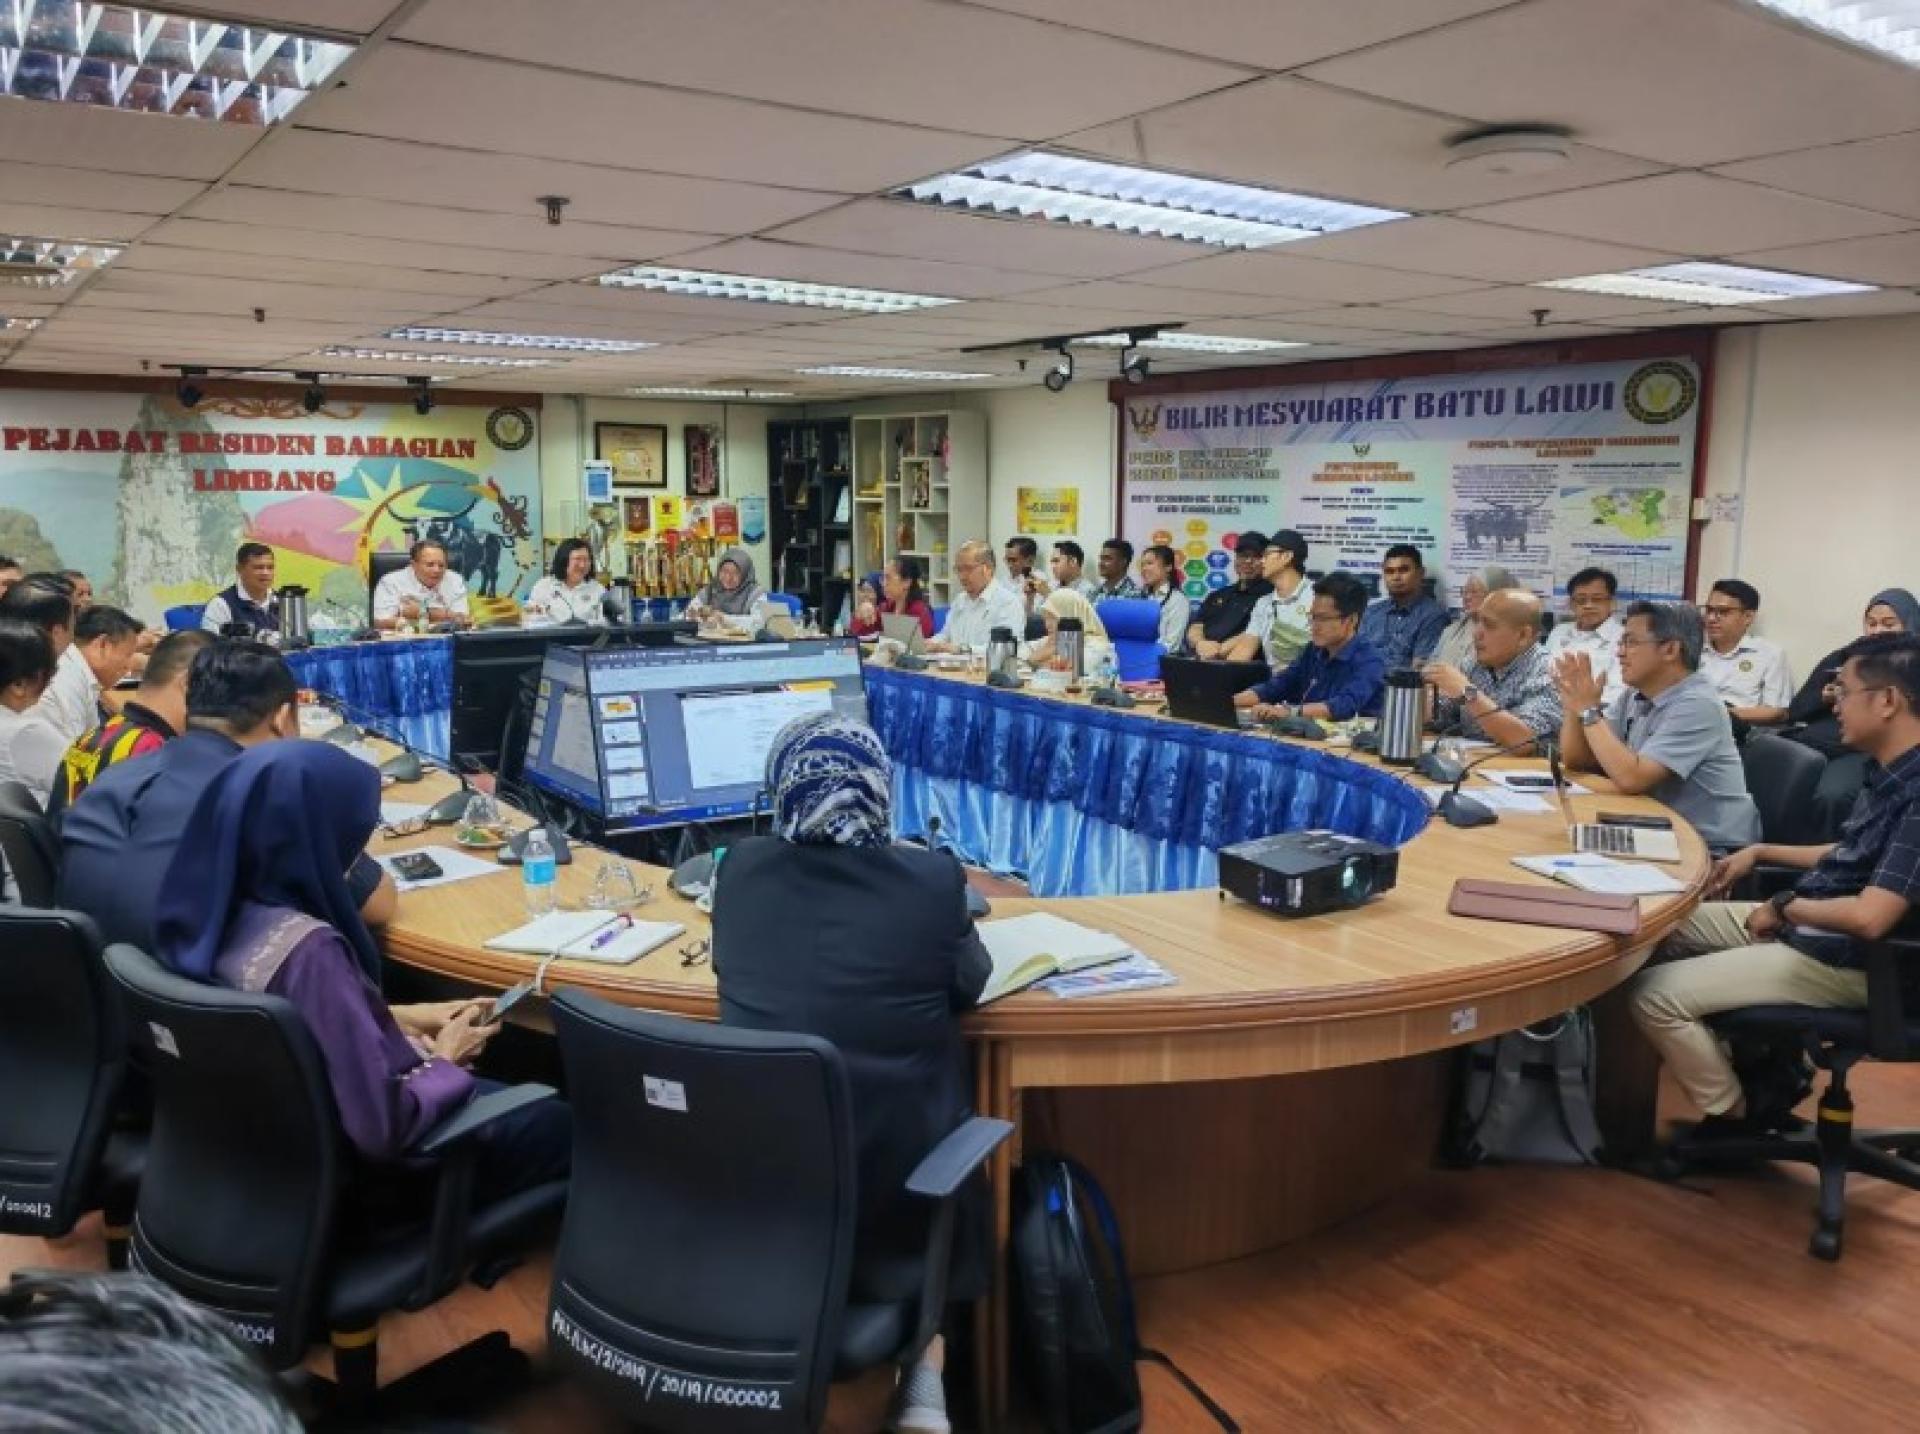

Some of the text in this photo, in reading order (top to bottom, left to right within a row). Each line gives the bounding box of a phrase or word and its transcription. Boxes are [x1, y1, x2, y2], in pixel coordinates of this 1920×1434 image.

[1166, 406, 1229, 430] BILIK
[1234, 394, 1407, 426] MESYUARAT
[1414, 386, 1505, 419] BATU
[1515, 381, 1615, 415] LAWI
[2, 428, 476, 459] PEJABAT RESIDEN BAHAGIAN
[193, 469, 337, 492] LIMBANG
